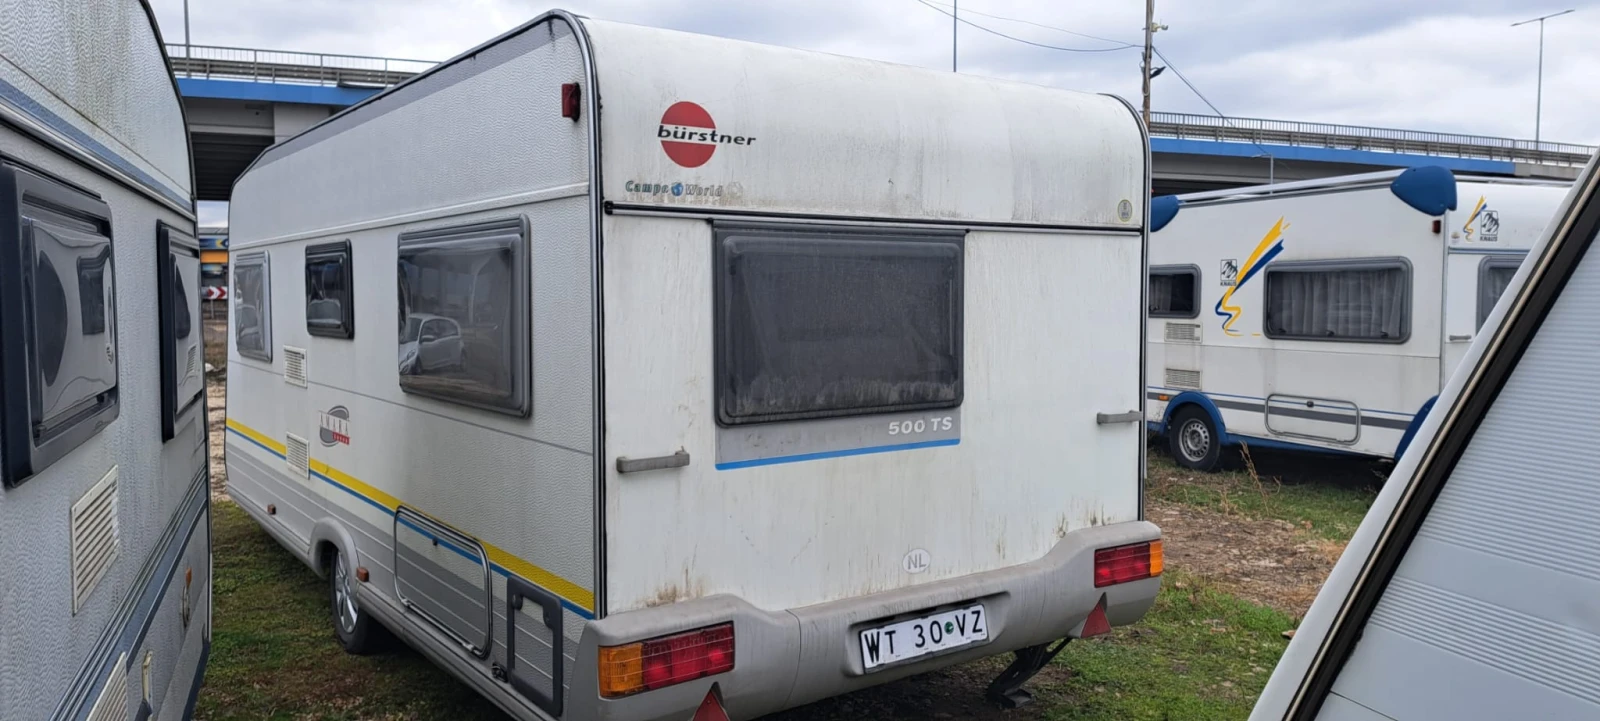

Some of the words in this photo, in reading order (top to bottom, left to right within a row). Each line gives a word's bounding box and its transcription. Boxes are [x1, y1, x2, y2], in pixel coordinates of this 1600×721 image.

[657, 125, 757, 146] bürstner
[685, 182, 724, 197] World
[319, 411, 349, 434] AMARA
[888, 419, 926, 435] 500
[930, 416, 953, 432] TS
[907, 553, 927, 570] NL
[864, 630, 896, 663] WT
[913, 620, 943, 648] 30
[954, 610, 983, 637] VZ
